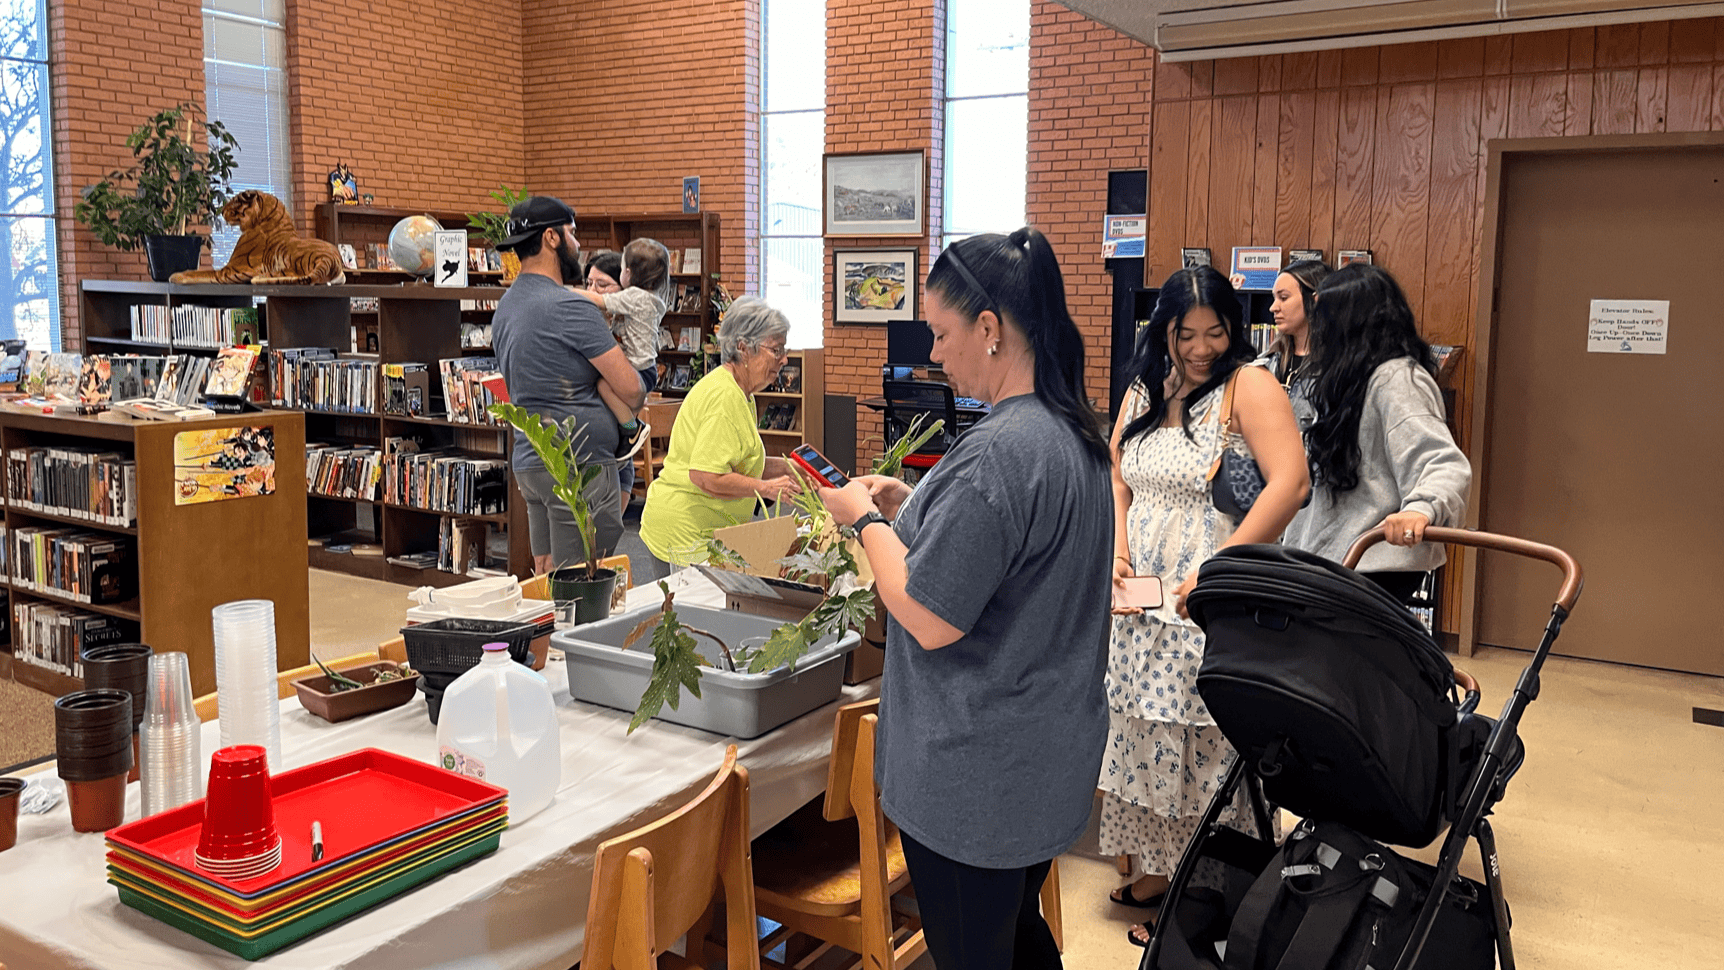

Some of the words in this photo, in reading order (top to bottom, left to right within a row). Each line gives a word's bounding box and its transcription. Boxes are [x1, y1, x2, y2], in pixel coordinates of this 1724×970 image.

[439, 234, 463, 246] Graphic
[442, 248, 462, 257] Novel
[1257, 256, 1270, 264] DVDS
